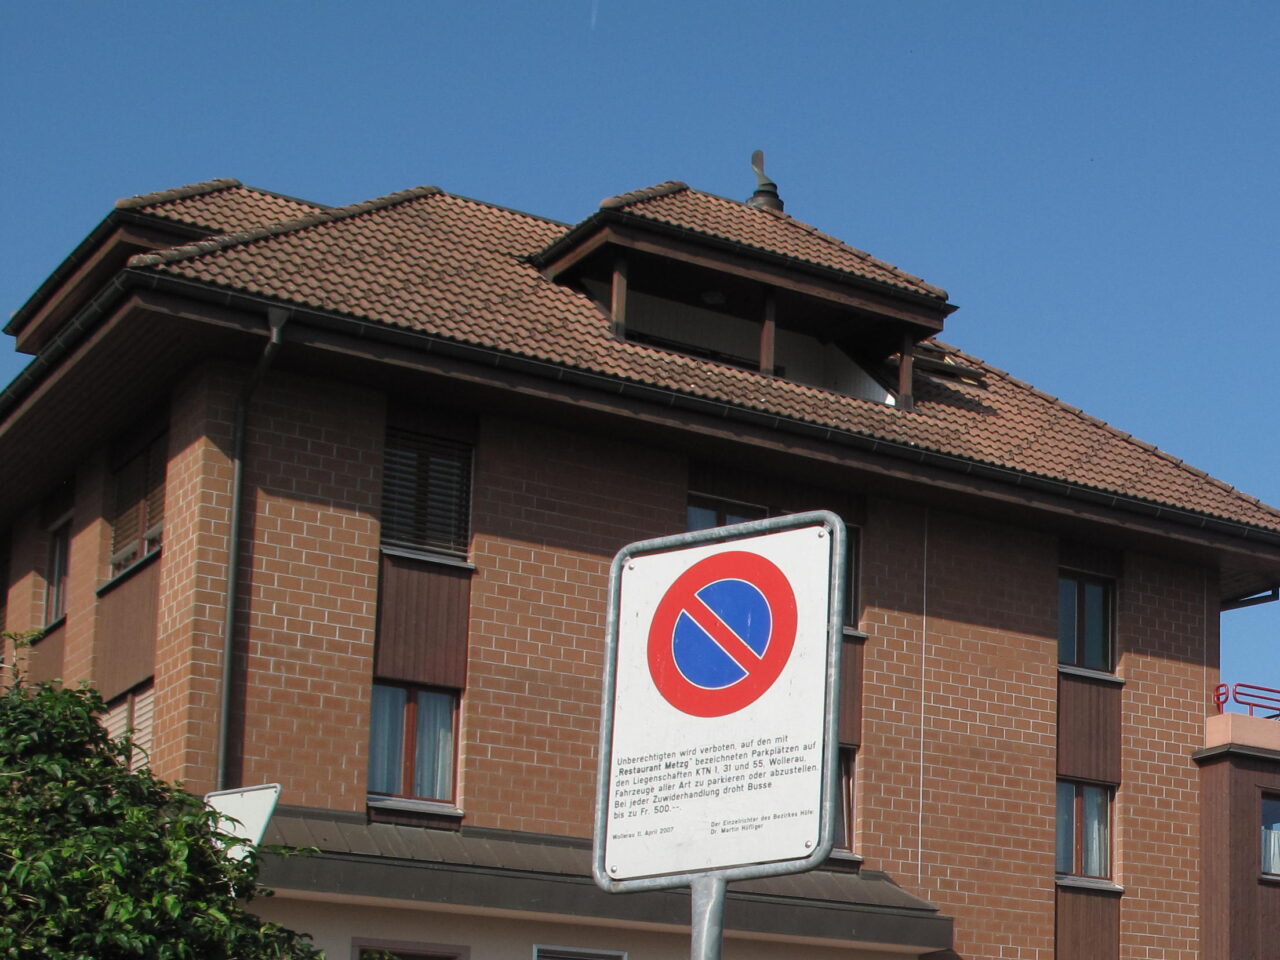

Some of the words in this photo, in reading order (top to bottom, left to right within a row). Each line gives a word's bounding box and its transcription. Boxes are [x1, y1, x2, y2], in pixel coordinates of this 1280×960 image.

[617, 752, 676, 766] Unberechtigten
[680, 747, 697, 757] wird
[740, 739, 754, 749] auf
[757, 737, 771, 747] den
[775, 735, 788, 744] mit
[695, 751, 748, 765] bezeichneten
[752, 745, 799, 758] Parkplätzen
[803, 741, 816, 751] auf
[615, 777, 630, 787] den
[633, 770, 692, 786] Liegenschaften
[695, 766, 711, 776] KTN
[723, 764, 731, 773] 31
[735, 761, 749, 771] und
[615, 786, 655, 798] Fahrzeuge
[658, 783, 675, 792] aller
[679, 780, 691, 789] Art
[695, 780, 704, 788] zu
[708, 774, 745, 787] parkieren
[748, 770, 766, 780] oder
[614, 800, 627, 809] Bei
[629, 797, 649, 808] jeder
[653, 788, 719, 803] Zuwiderhandlung
[723, 784, 744, 795] droht
[747, 781, 772, 791] Busse
[613, 811, 624, 820] bis
[628, 809, 637, 818] zu
[640, 807, 650, 816] Fr.
